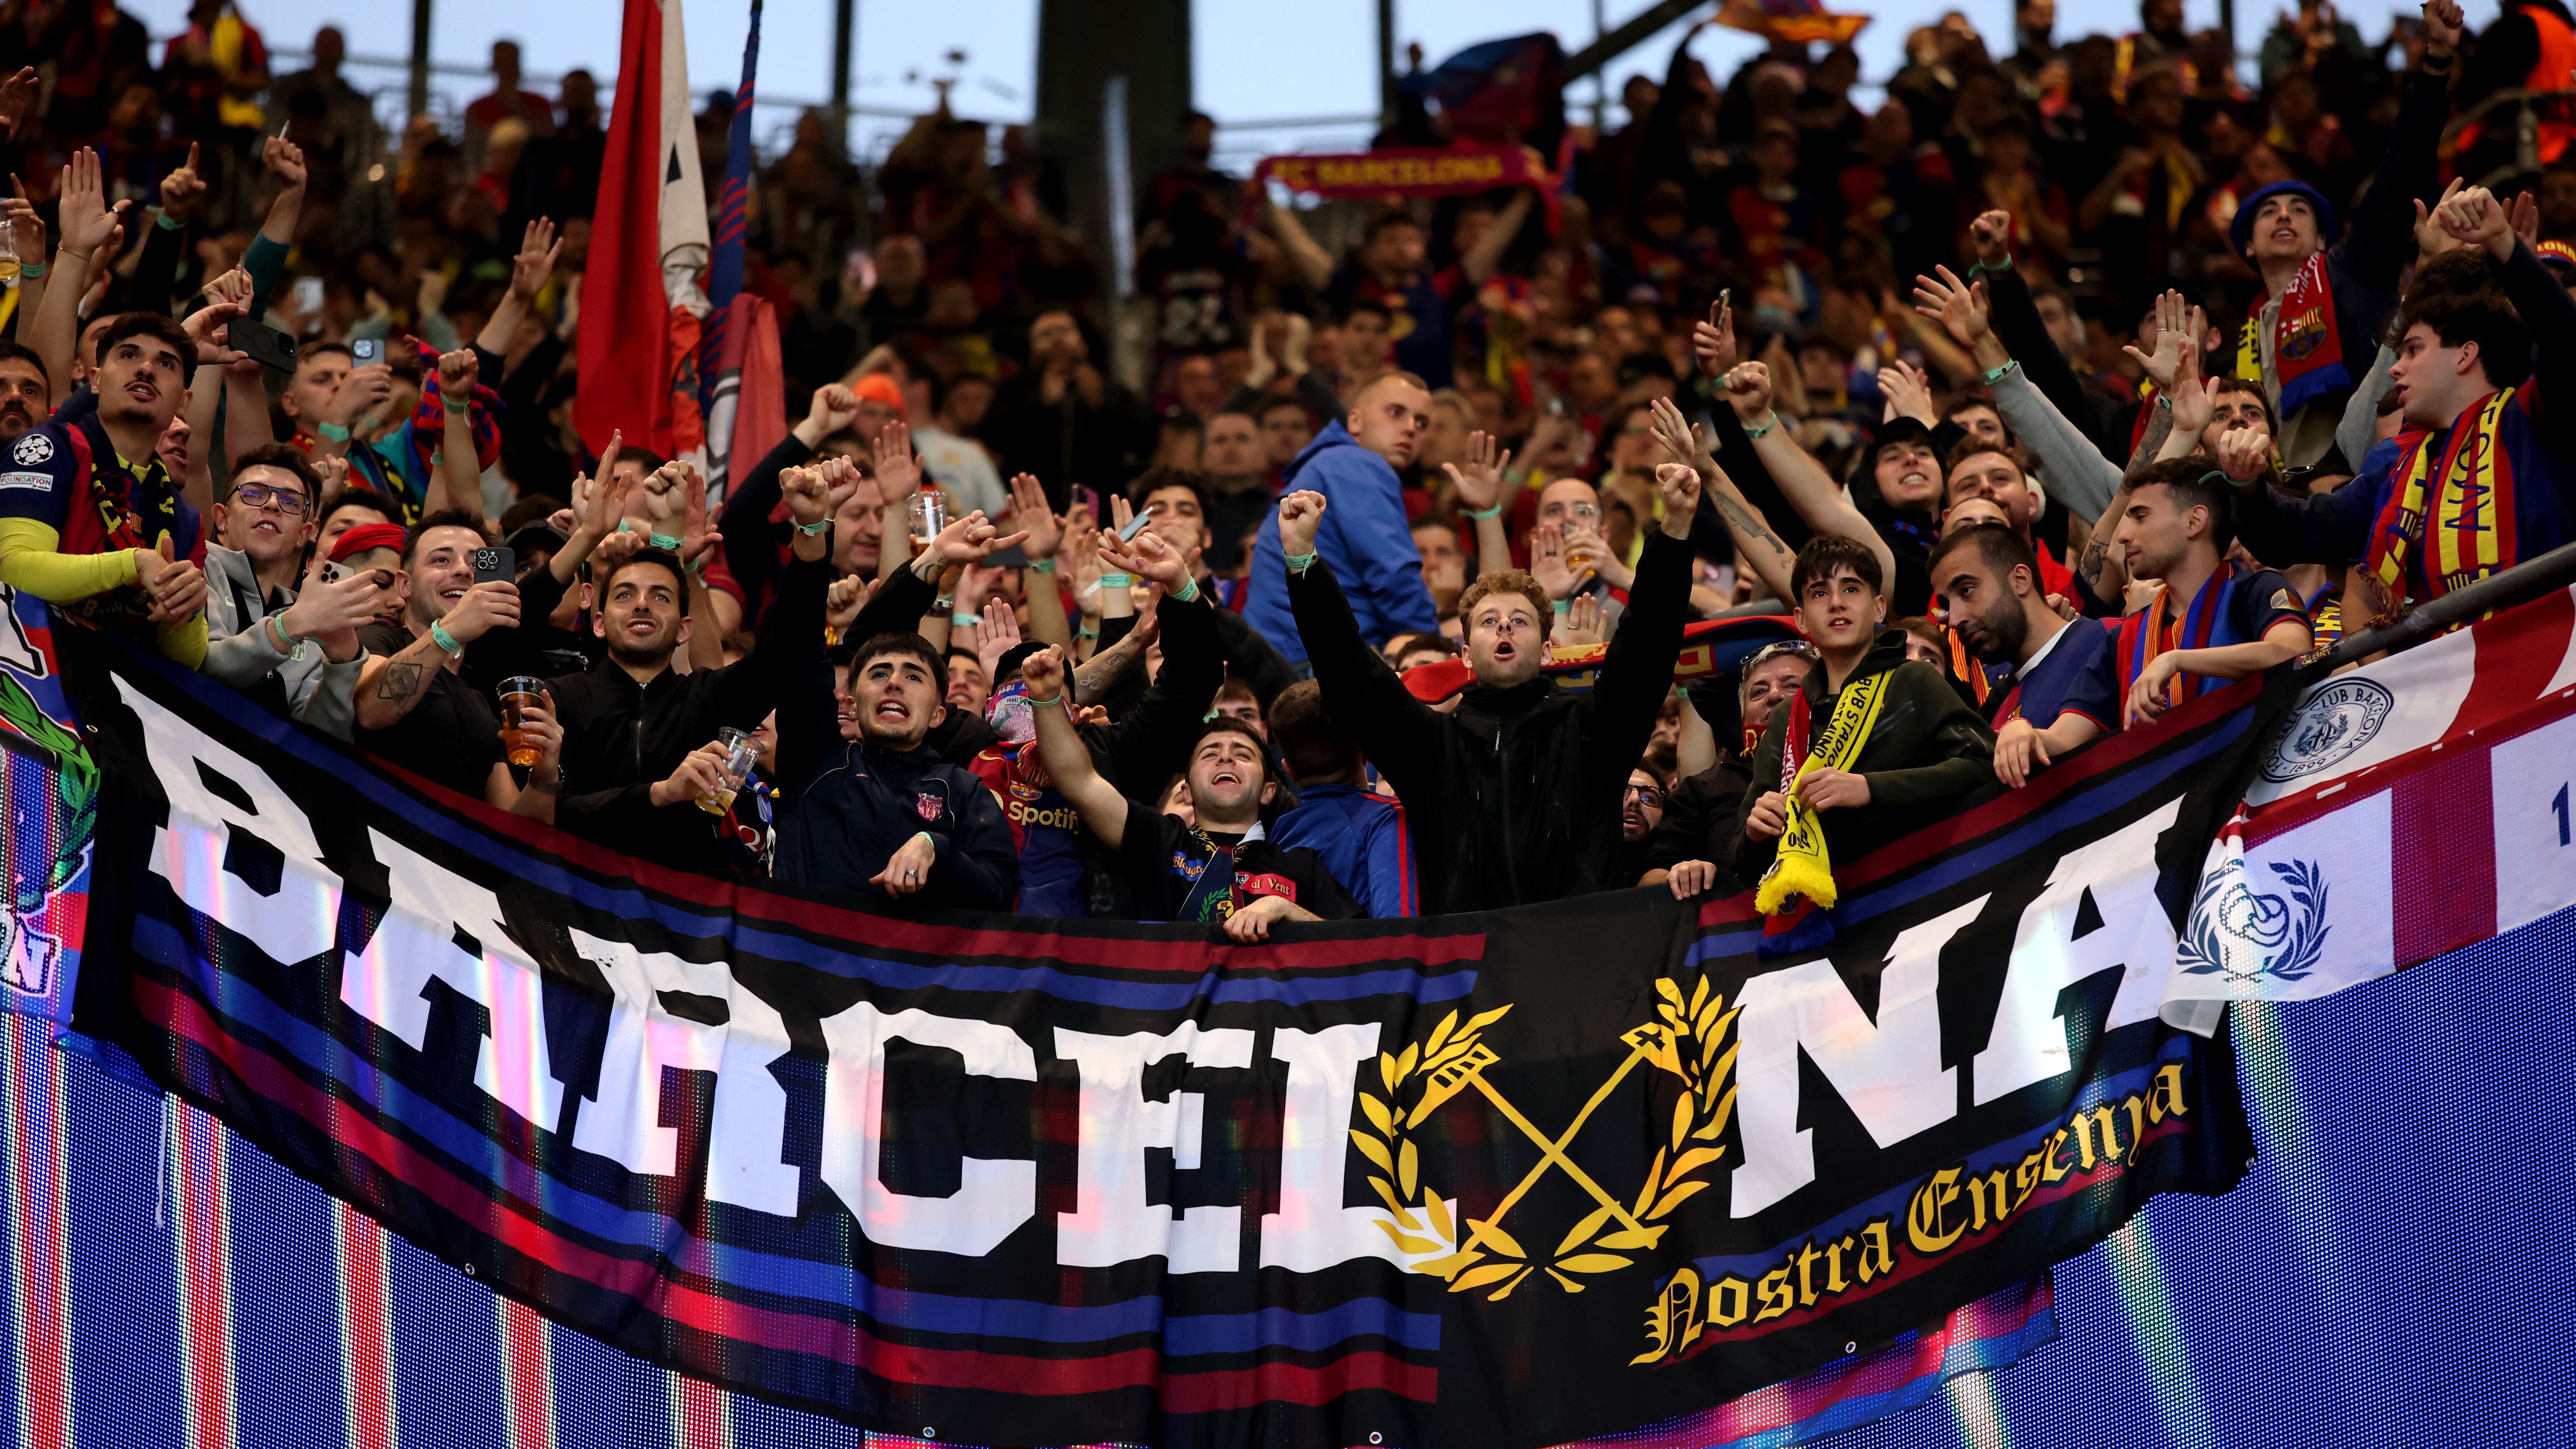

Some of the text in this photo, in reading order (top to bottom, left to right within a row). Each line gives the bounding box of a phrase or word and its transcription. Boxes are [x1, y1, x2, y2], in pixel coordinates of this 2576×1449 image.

[1316, 156, 1503, 186] BARCELONA
[2537, 241, 2576, 262] LONA
[1, 476, 51, 485] FOUNDATION
[1824, 677, 1873, 769] BVB STADIO
[2309, 688, 2349, 711] CLUB
[2341, 688, 2384, 749] BARCELONA
[2289, 758, 2326, 774] 1899
[2552, 781, 2570, 846] 1
[1251, 878, 1263, 889] al
[1268, 878, 1290, 895] Vent
[1629, 1063, 2188, 1367] Nostra Ensenya
